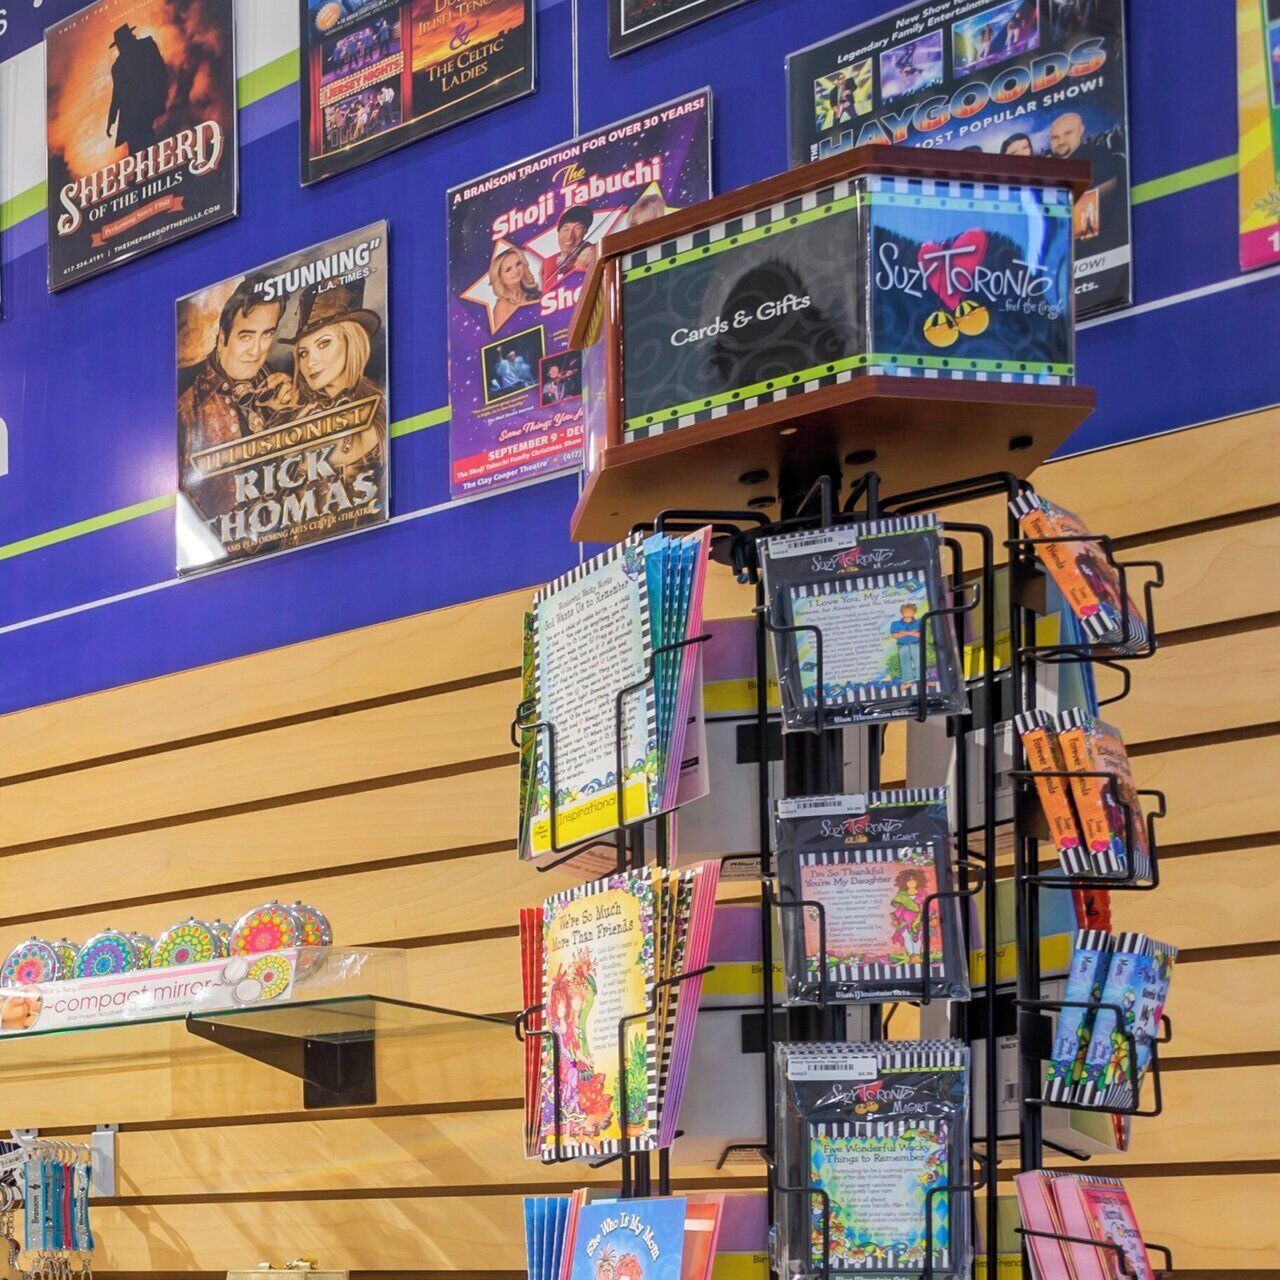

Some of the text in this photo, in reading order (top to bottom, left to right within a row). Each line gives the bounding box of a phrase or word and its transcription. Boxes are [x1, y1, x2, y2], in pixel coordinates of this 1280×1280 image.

[896, 13, 920, 29] New
[837, 22, 925, 64] Legendary Family
[426, 39, 504, 83] THE CELTIC
[442, 62, 488, 93] LADIES
[810, 36, 1107, 161] THE HAYGOODS
[959, 77, 1104, 135] POPULAR SHOW!
[453, 98, 705, 204] A BRANSON TRADITION FOR OVER 30 YEARS!
[57, 120, 224, 236] SHEPHERD
[552, 163, 585, 187] The
[89, 171, 183, 222] OF THE HILLS
[492, 157, 661, 240] Shoji Tabuchi
[339, 267, 370, 286] TIMES
[876, 242, 1053, 299] SUZY TORONTO
[670, 292, 811, 348] Cards & Gifts
[205, 406, 364, 470] ILLUSIONIST
[487, 435, 548, 461] SEPTEMBER
[234, 444, 336, 505] RICK
[595, 580, 629, 604] Remember
[557, 793, 617, 827] Inspirational
[805, 875, 892, 888] You're My Daughter
[810, 866, 885, 878] I'm So Thankful
[558, 900, 622, 932] We're So Much
[572, 928, 594, 946] Than
[597, 919, 634, 940] Friends
[823, 1142, 932, 1155] Five Wonderful Wacky
[826, 1152, 926, 1164] Things to Remember
[32, 1194, 40, 1224] Branson
[600, 1215, 618, 1236] Who
[620, 1212, 630, 1228] Is
[630, 1214, 645, 1237] My
[643, 1230, 660, 1262] Mom
